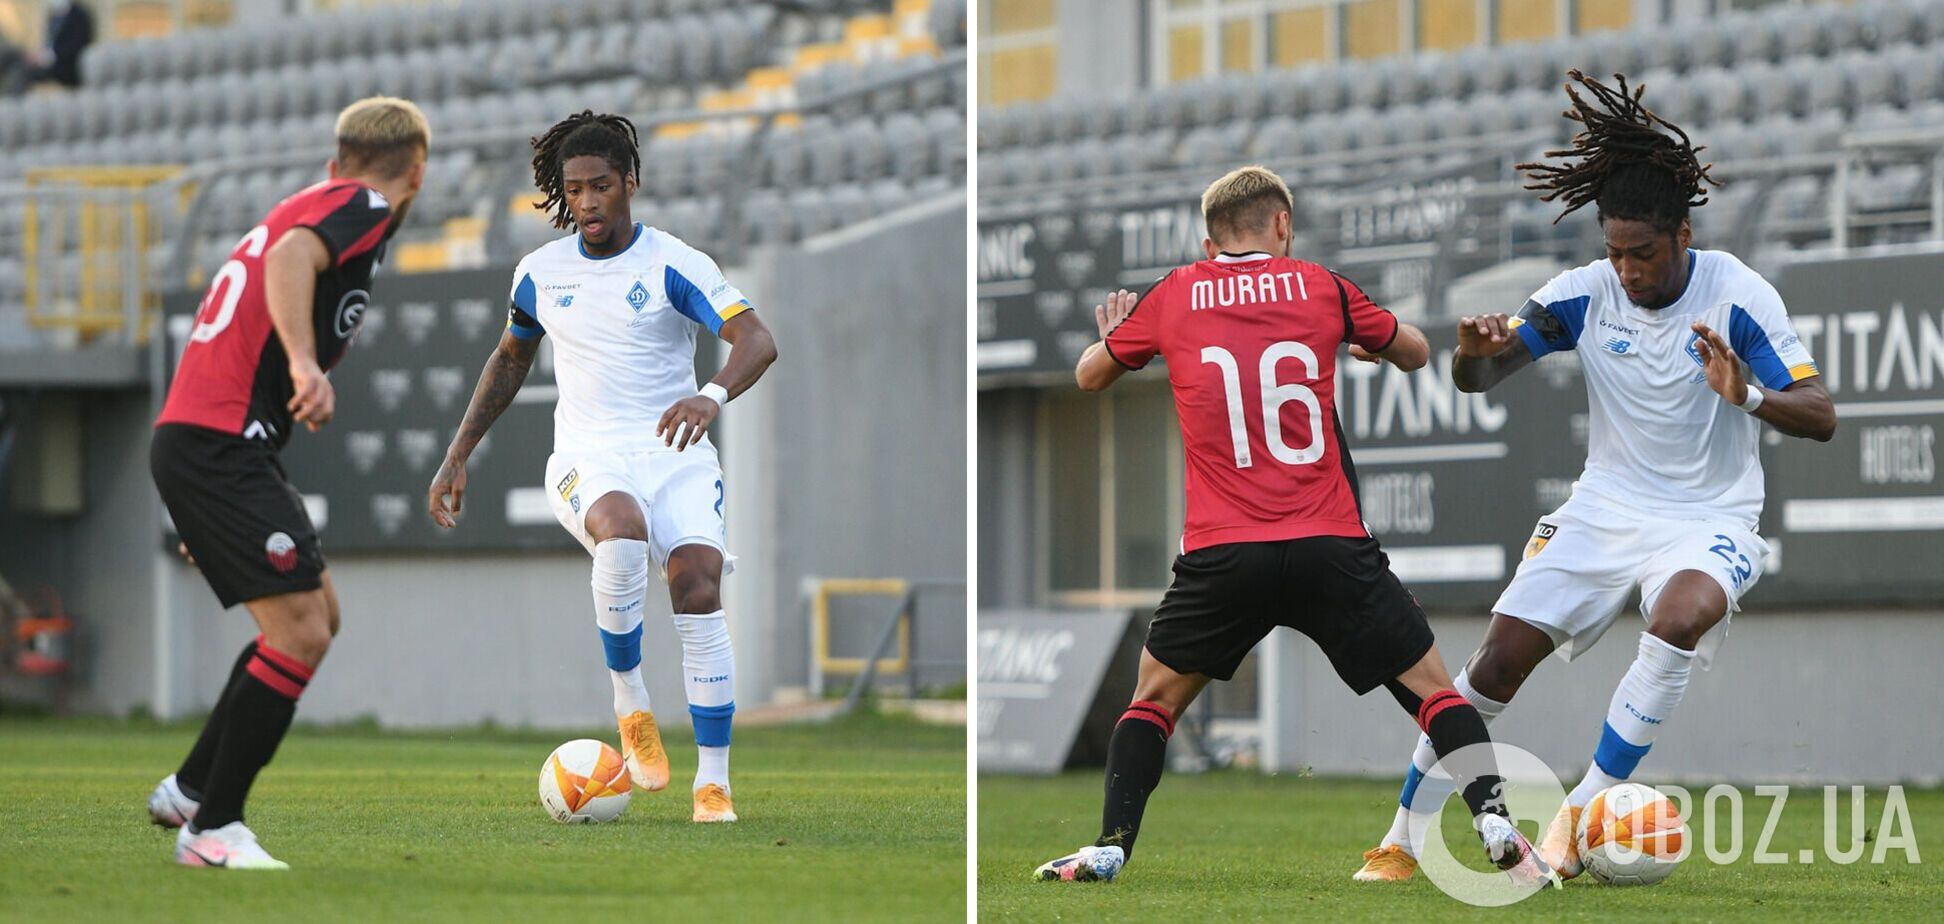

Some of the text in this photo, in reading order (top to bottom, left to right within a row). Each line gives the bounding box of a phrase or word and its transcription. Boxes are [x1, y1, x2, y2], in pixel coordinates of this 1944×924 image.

[1191, 271, 1308, 311] MURATI
[1200, 341, 1326, 470] 16
[1860, 424, 1936, 485] HOTELS
[1709, 534, 1751, 588] 22
[1625, 702, 1662, 726] FCDK
